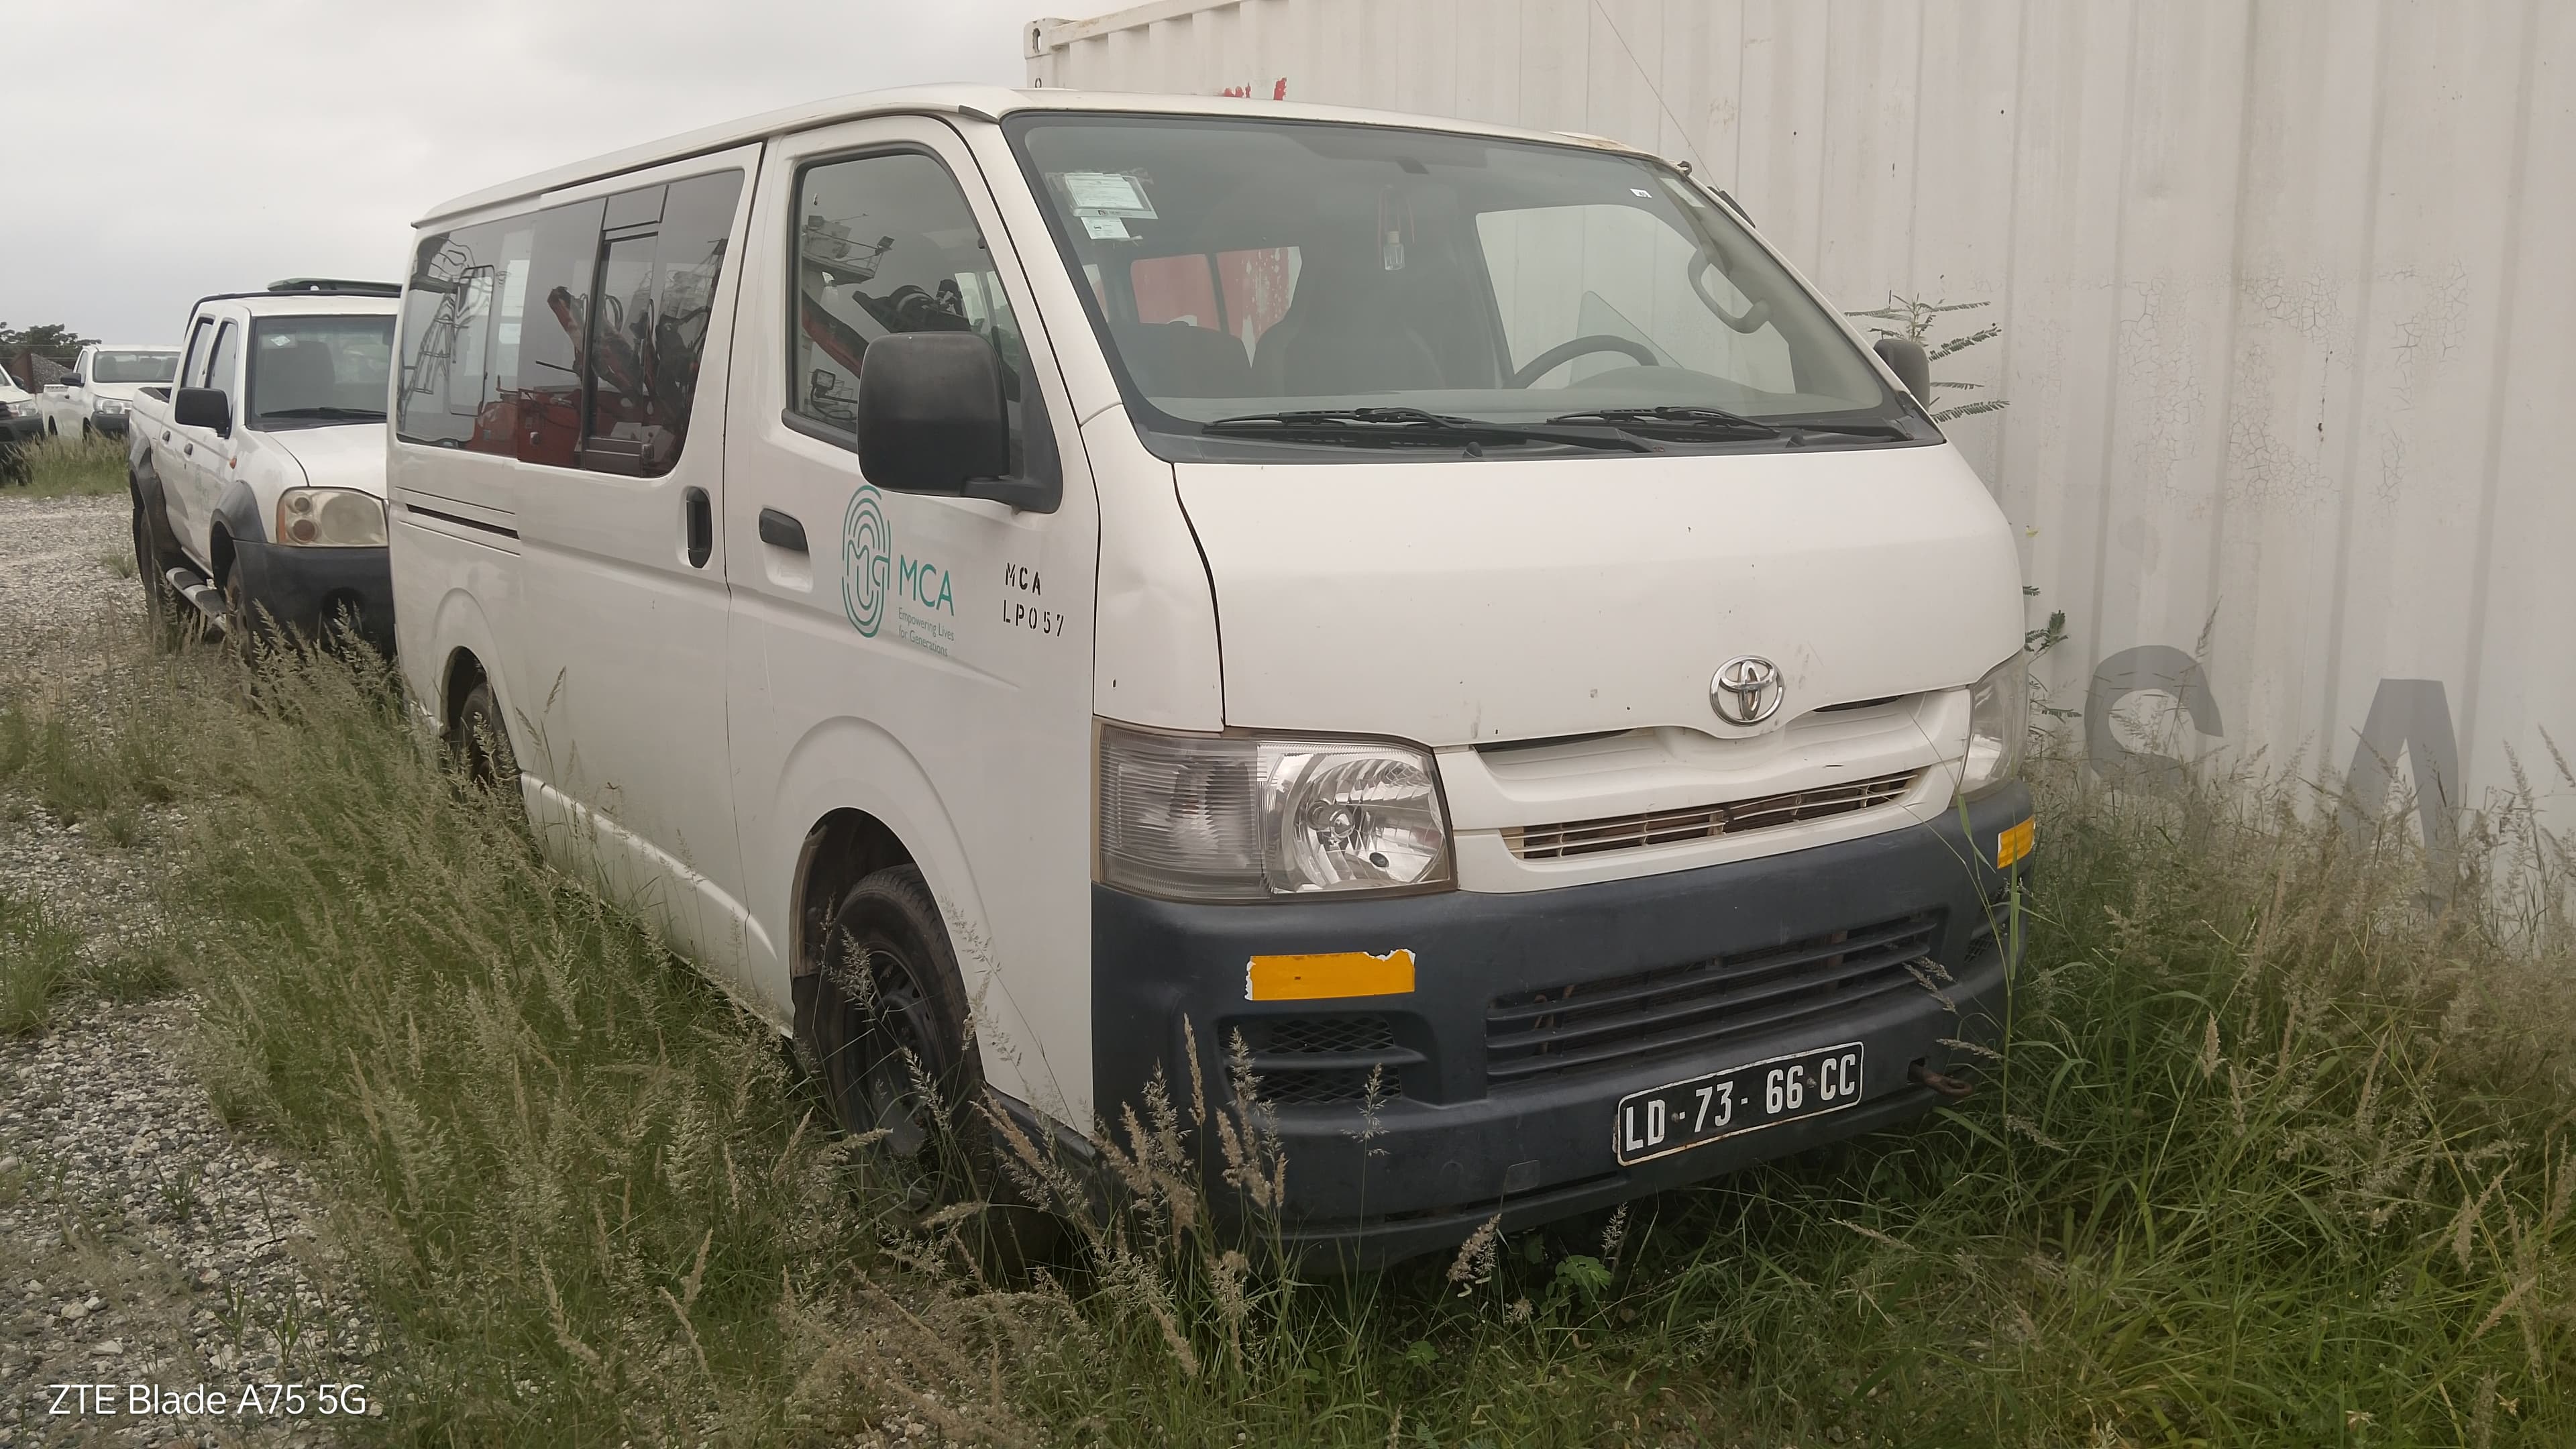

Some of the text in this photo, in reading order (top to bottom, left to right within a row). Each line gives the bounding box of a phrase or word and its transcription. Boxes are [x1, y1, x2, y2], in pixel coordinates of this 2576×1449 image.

[899, 554, 955, 616] MCA
[1005, 562, 1041, 596] MCA
[898, 606, 955, 641] Empowering Lives
[898, 625, 949, 657] for Generations
